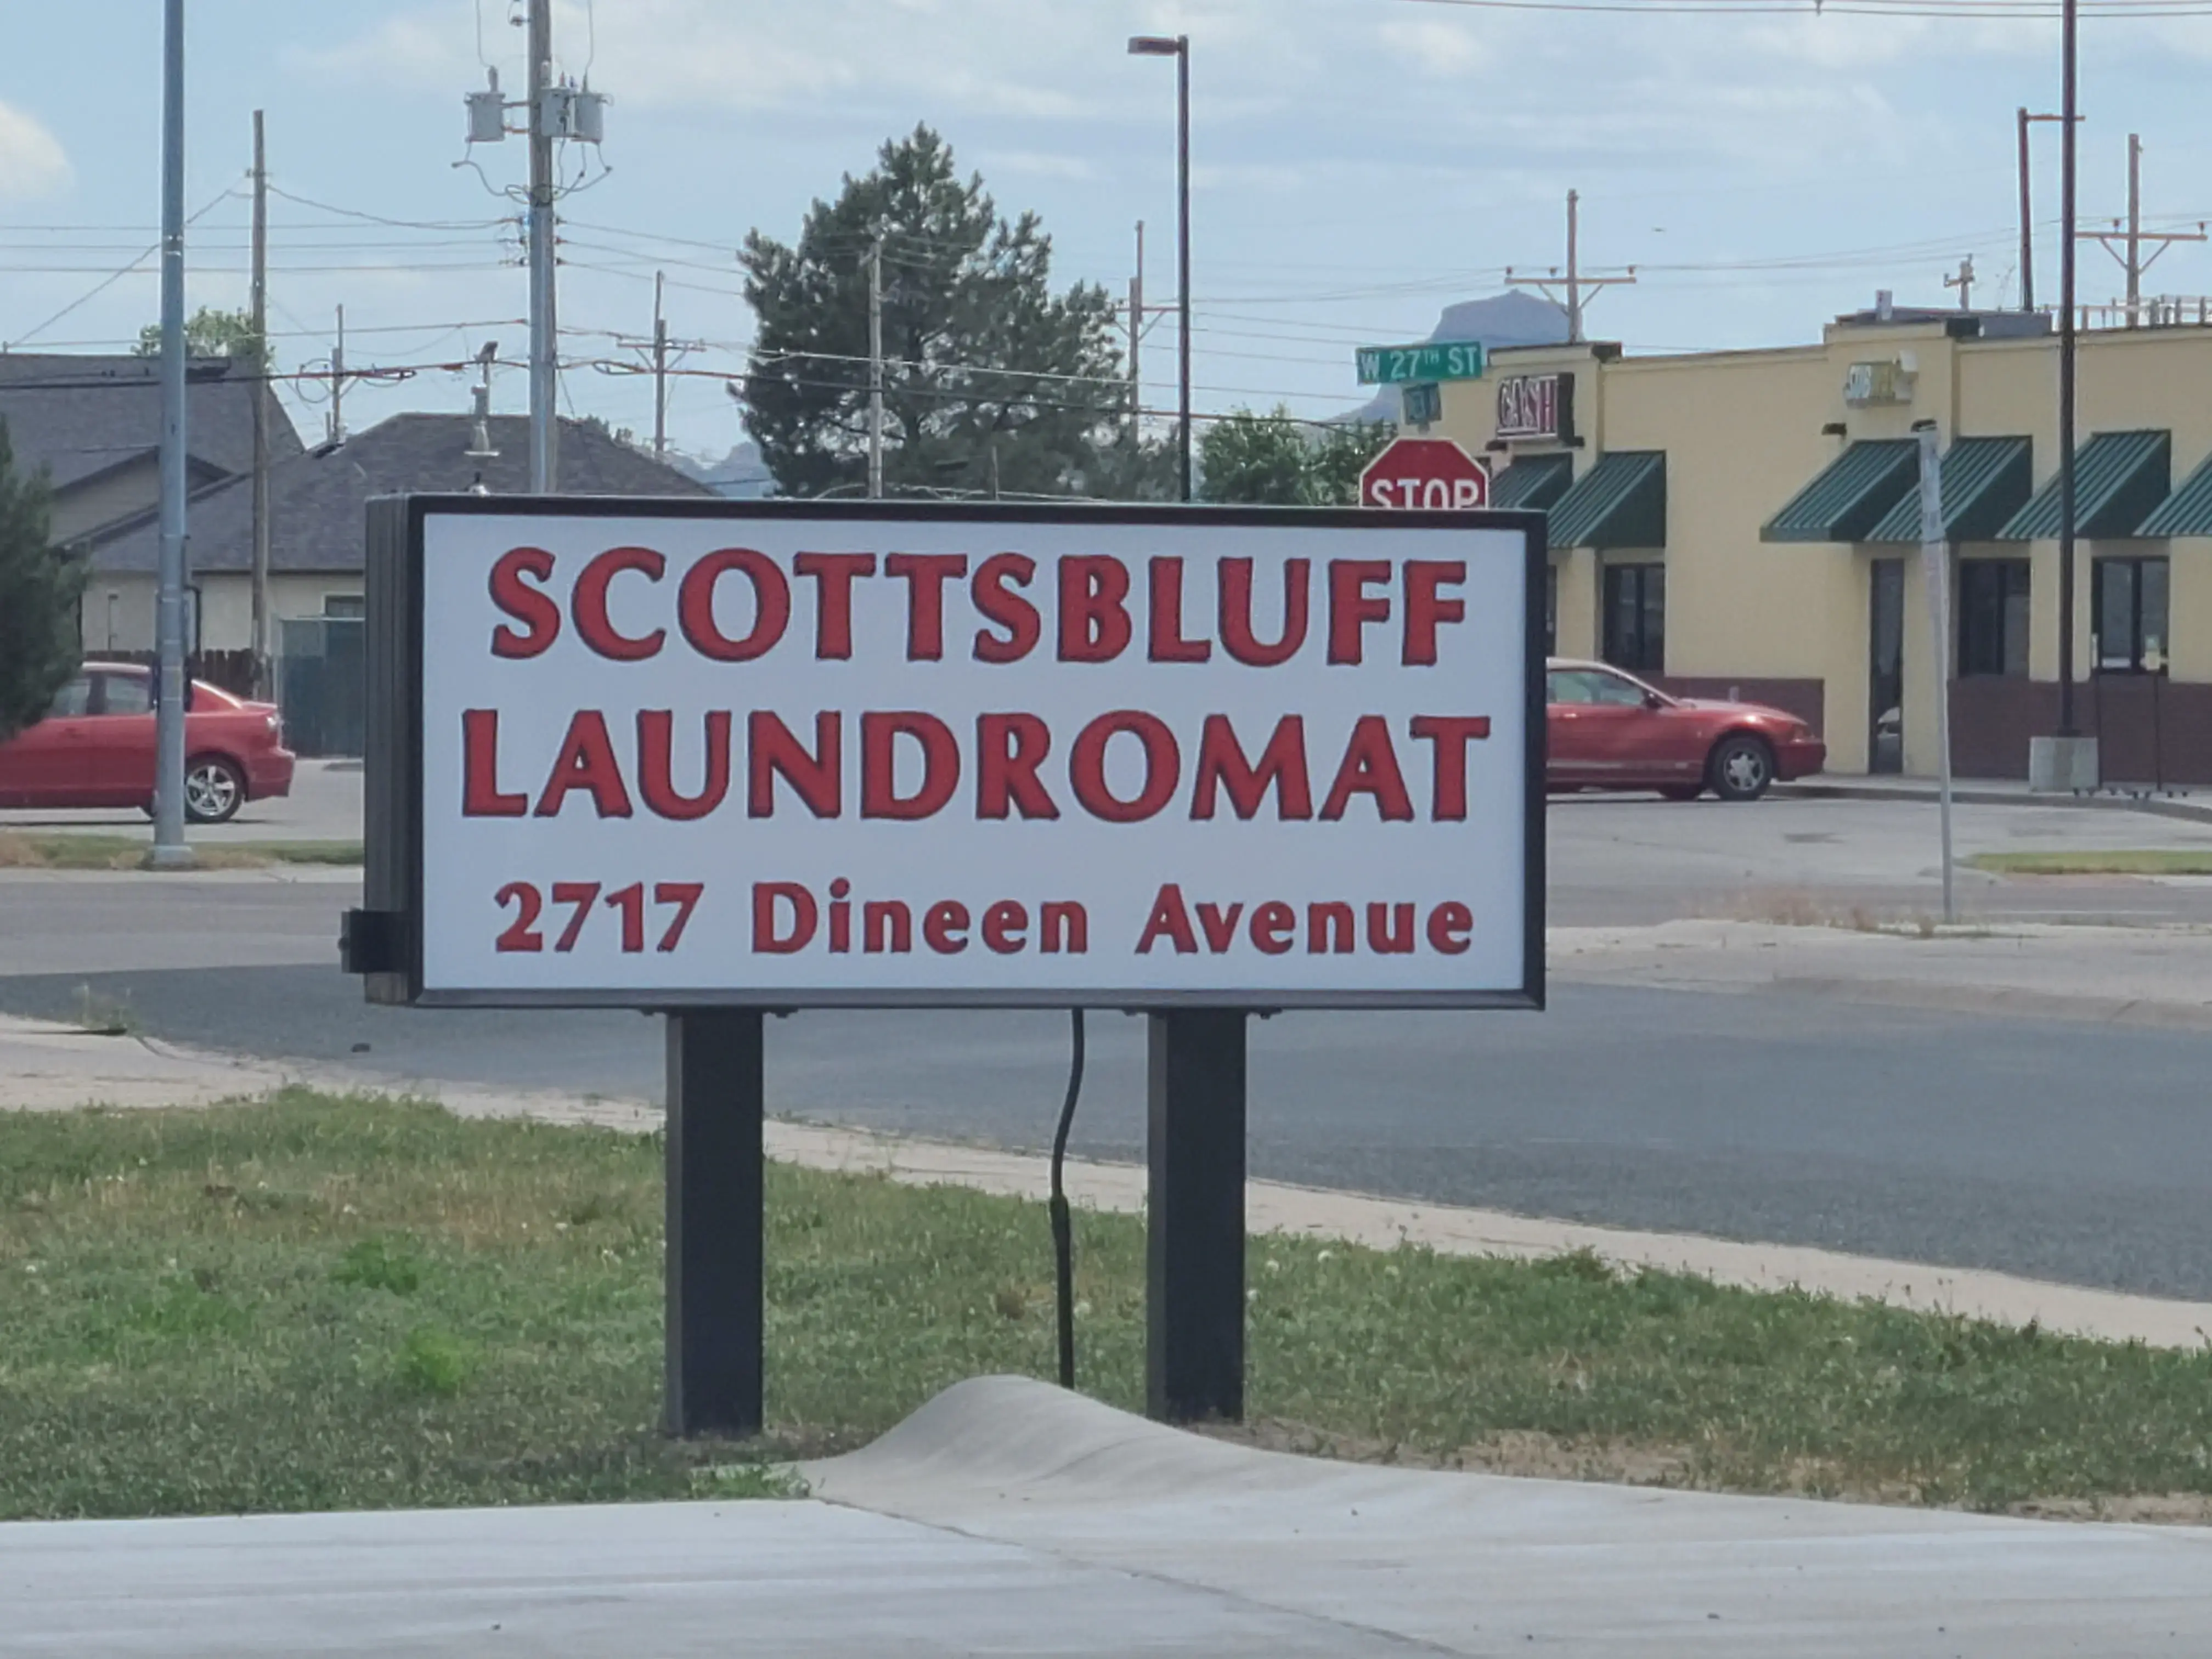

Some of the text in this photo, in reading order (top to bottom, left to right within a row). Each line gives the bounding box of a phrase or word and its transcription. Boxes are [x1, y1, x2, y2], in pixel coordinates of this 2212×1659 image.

[1361, 352, 1380, 381] W
[1448, 345, 1477, 375] ST
[1372, 478, 1480, 509] STOP
[488, 546, 1467, 667] SCOTTSBLUFF
[461, 708, 1491, 822] LAUNDROMAT
[494, 877, 1474, 956] 2717 Dineen Avenue
